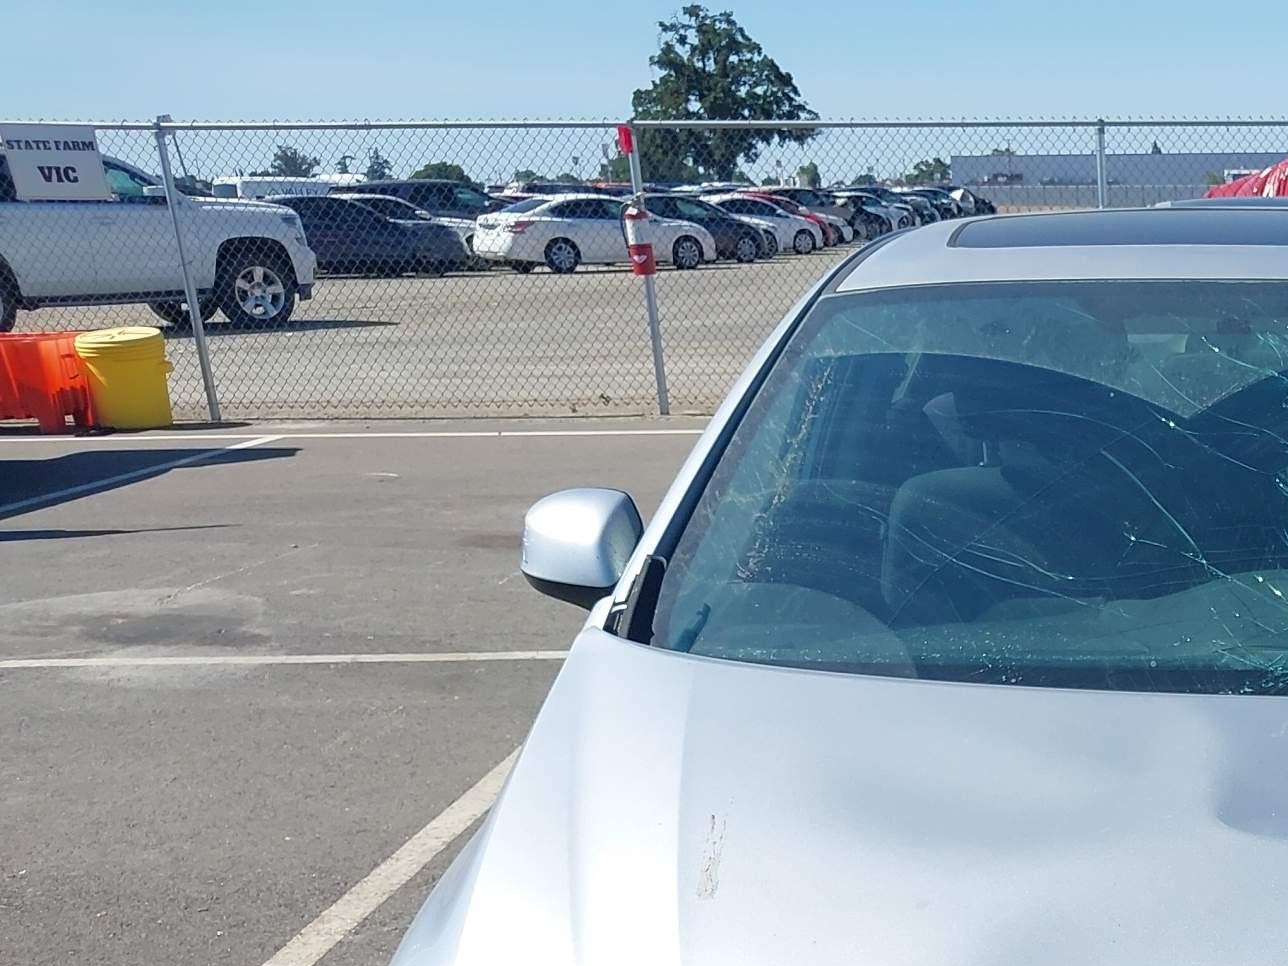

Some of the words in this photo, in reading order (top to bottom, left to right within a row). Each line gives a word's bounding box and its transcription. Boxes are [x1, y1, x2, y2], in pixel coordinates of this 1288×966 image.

[6, 140, 51, 151] STATE
[54, 141, 95, 151] FARM
[37, 165, 79, 183] VIC
